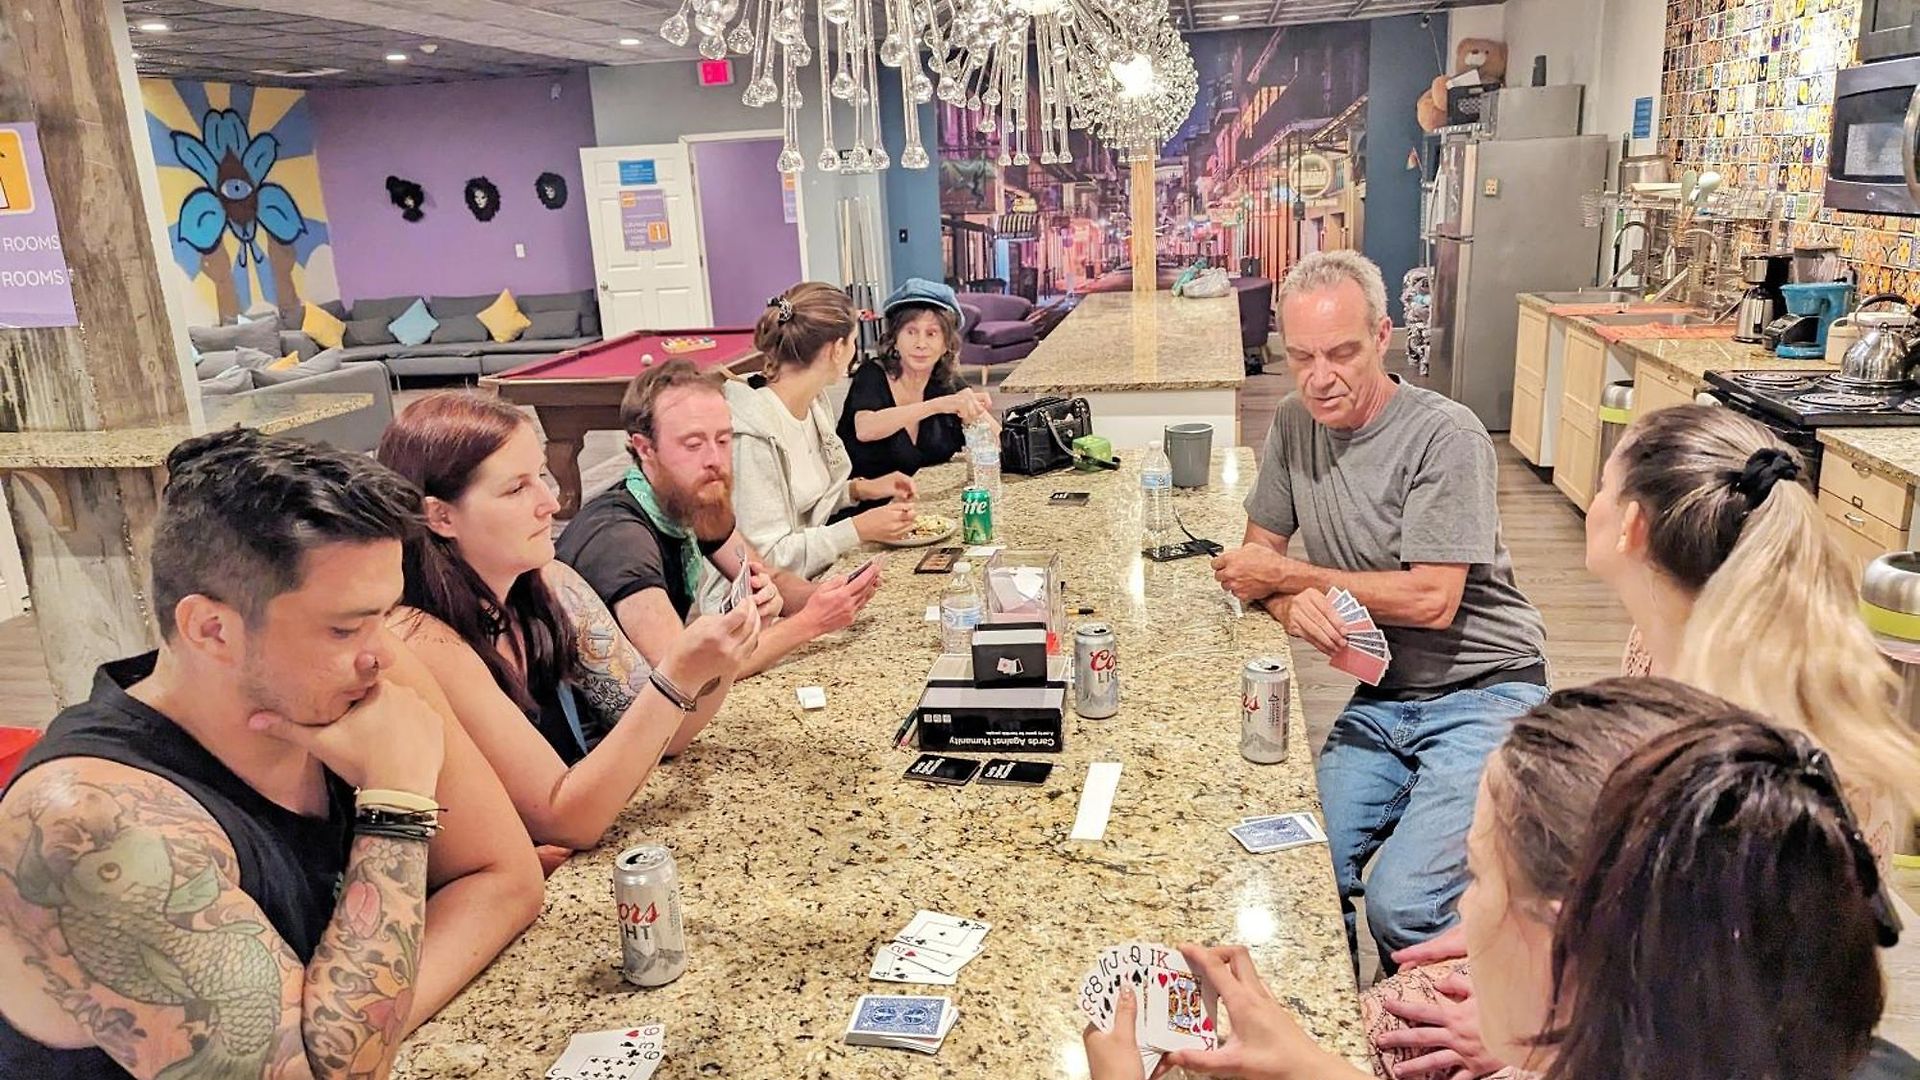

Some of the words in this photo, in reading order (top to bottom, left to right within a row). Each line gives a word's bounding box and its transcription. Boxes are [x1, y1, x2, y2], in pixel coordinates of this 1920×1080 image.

[3, 234, 61, 252] ROOMS
[1, 269, 65, 287] ROOMS
[949, 736, 991, 746] Humanity
[992, 736, 1025, 746] Against
[1027, 737, 1055, 746] Cards
[1109, 951, 1118, 969] J
[1130, 945, 1142, 966] Q
[1156, 950, 1169, 970] K
